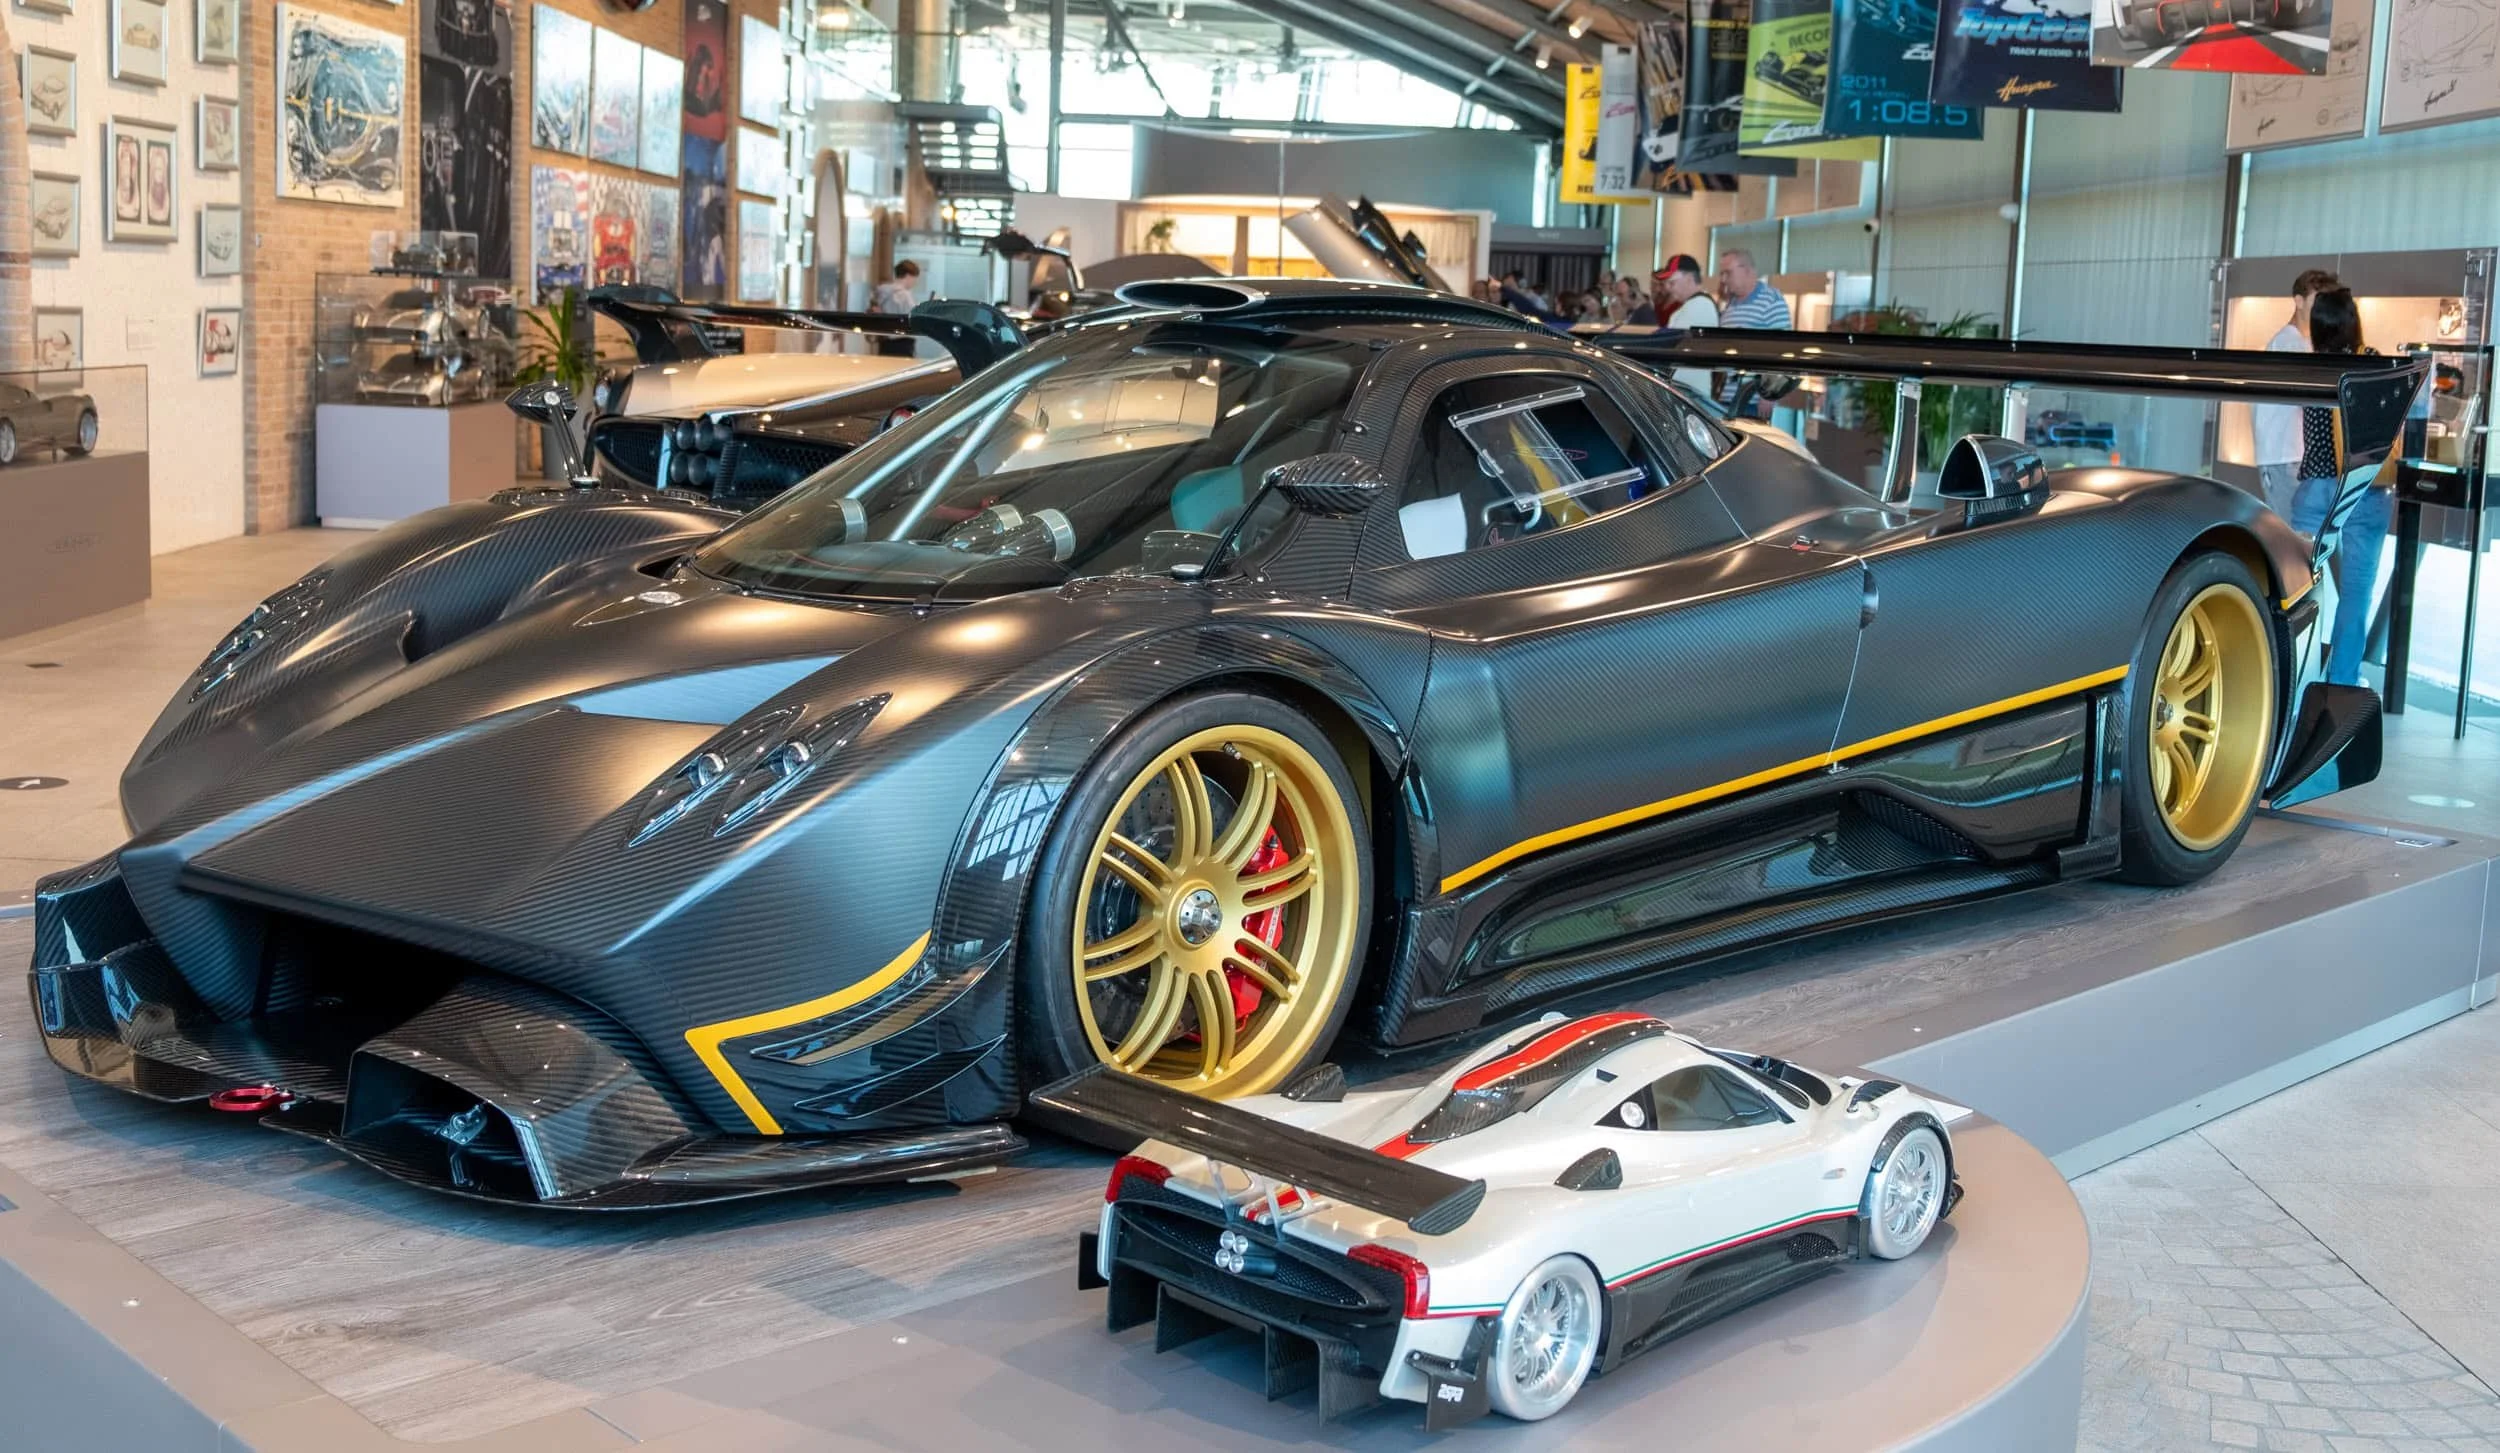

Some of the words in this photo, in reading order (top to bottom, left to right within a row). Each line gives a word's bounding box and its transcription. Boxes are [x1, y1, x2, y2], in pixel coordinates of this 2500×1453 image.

[1954, 8, 2090, 45] TopGea
[1840, 73, 1887, 88] 2011
[1848, 99, 1968, 126] 1:08.5
